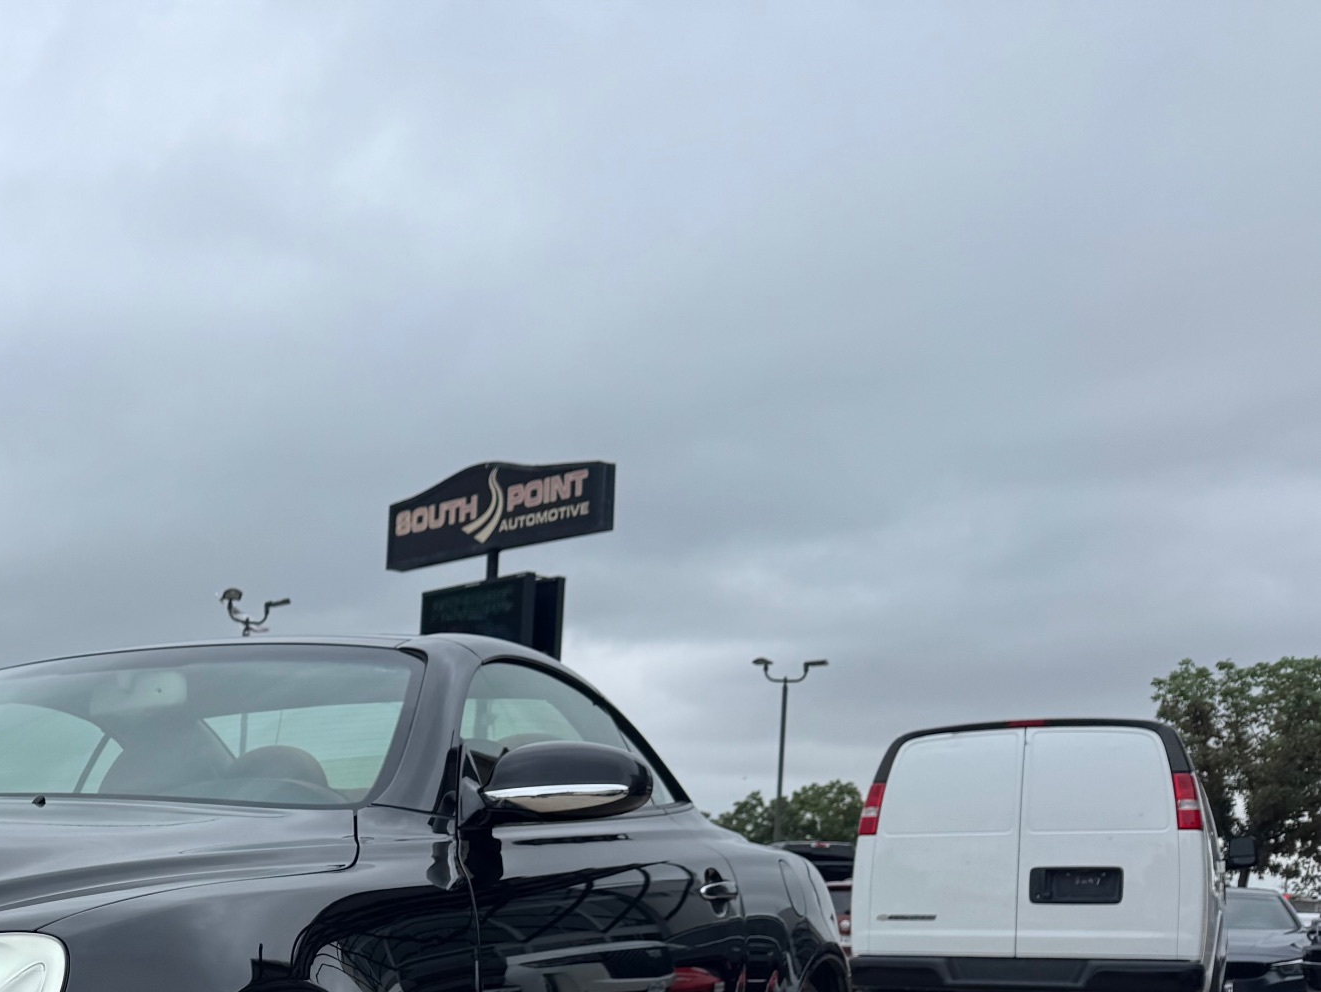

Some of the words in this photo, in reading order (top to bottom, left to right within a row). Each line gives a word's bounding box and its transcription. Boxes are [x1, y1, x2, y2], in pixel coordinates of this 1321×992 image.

[395, 494, 479, 537] SOUTH
[506, 468, 590, 513] POINT
[498, 500, 590, 534] AUTOMOTIVE
